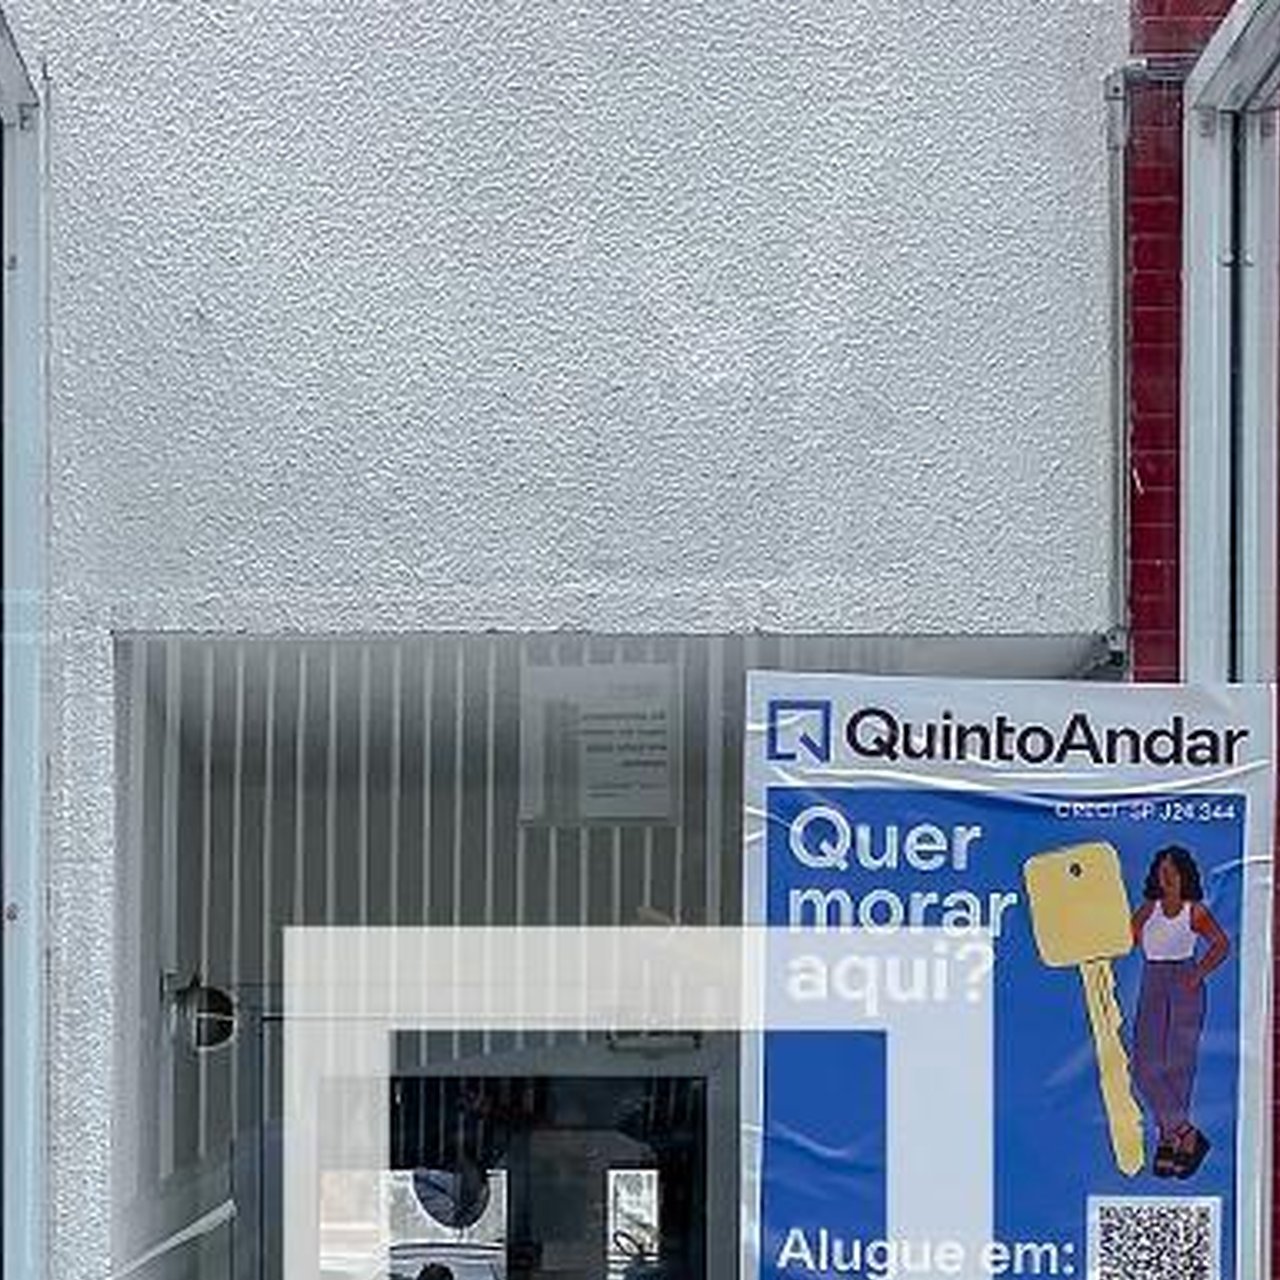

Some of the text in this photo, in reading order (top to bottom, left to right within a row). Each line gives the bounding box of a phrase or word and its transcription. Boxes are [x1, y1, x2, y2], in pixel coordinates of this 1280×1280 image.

[846, 707, 1250, 766] QuintoAndar
[789, 806, 982, 871] Quer
[789, 888, 1018, 938] morar
[787, 941, 995, 1018] aqui?
[983, 1241, 1075, 1275] em:
